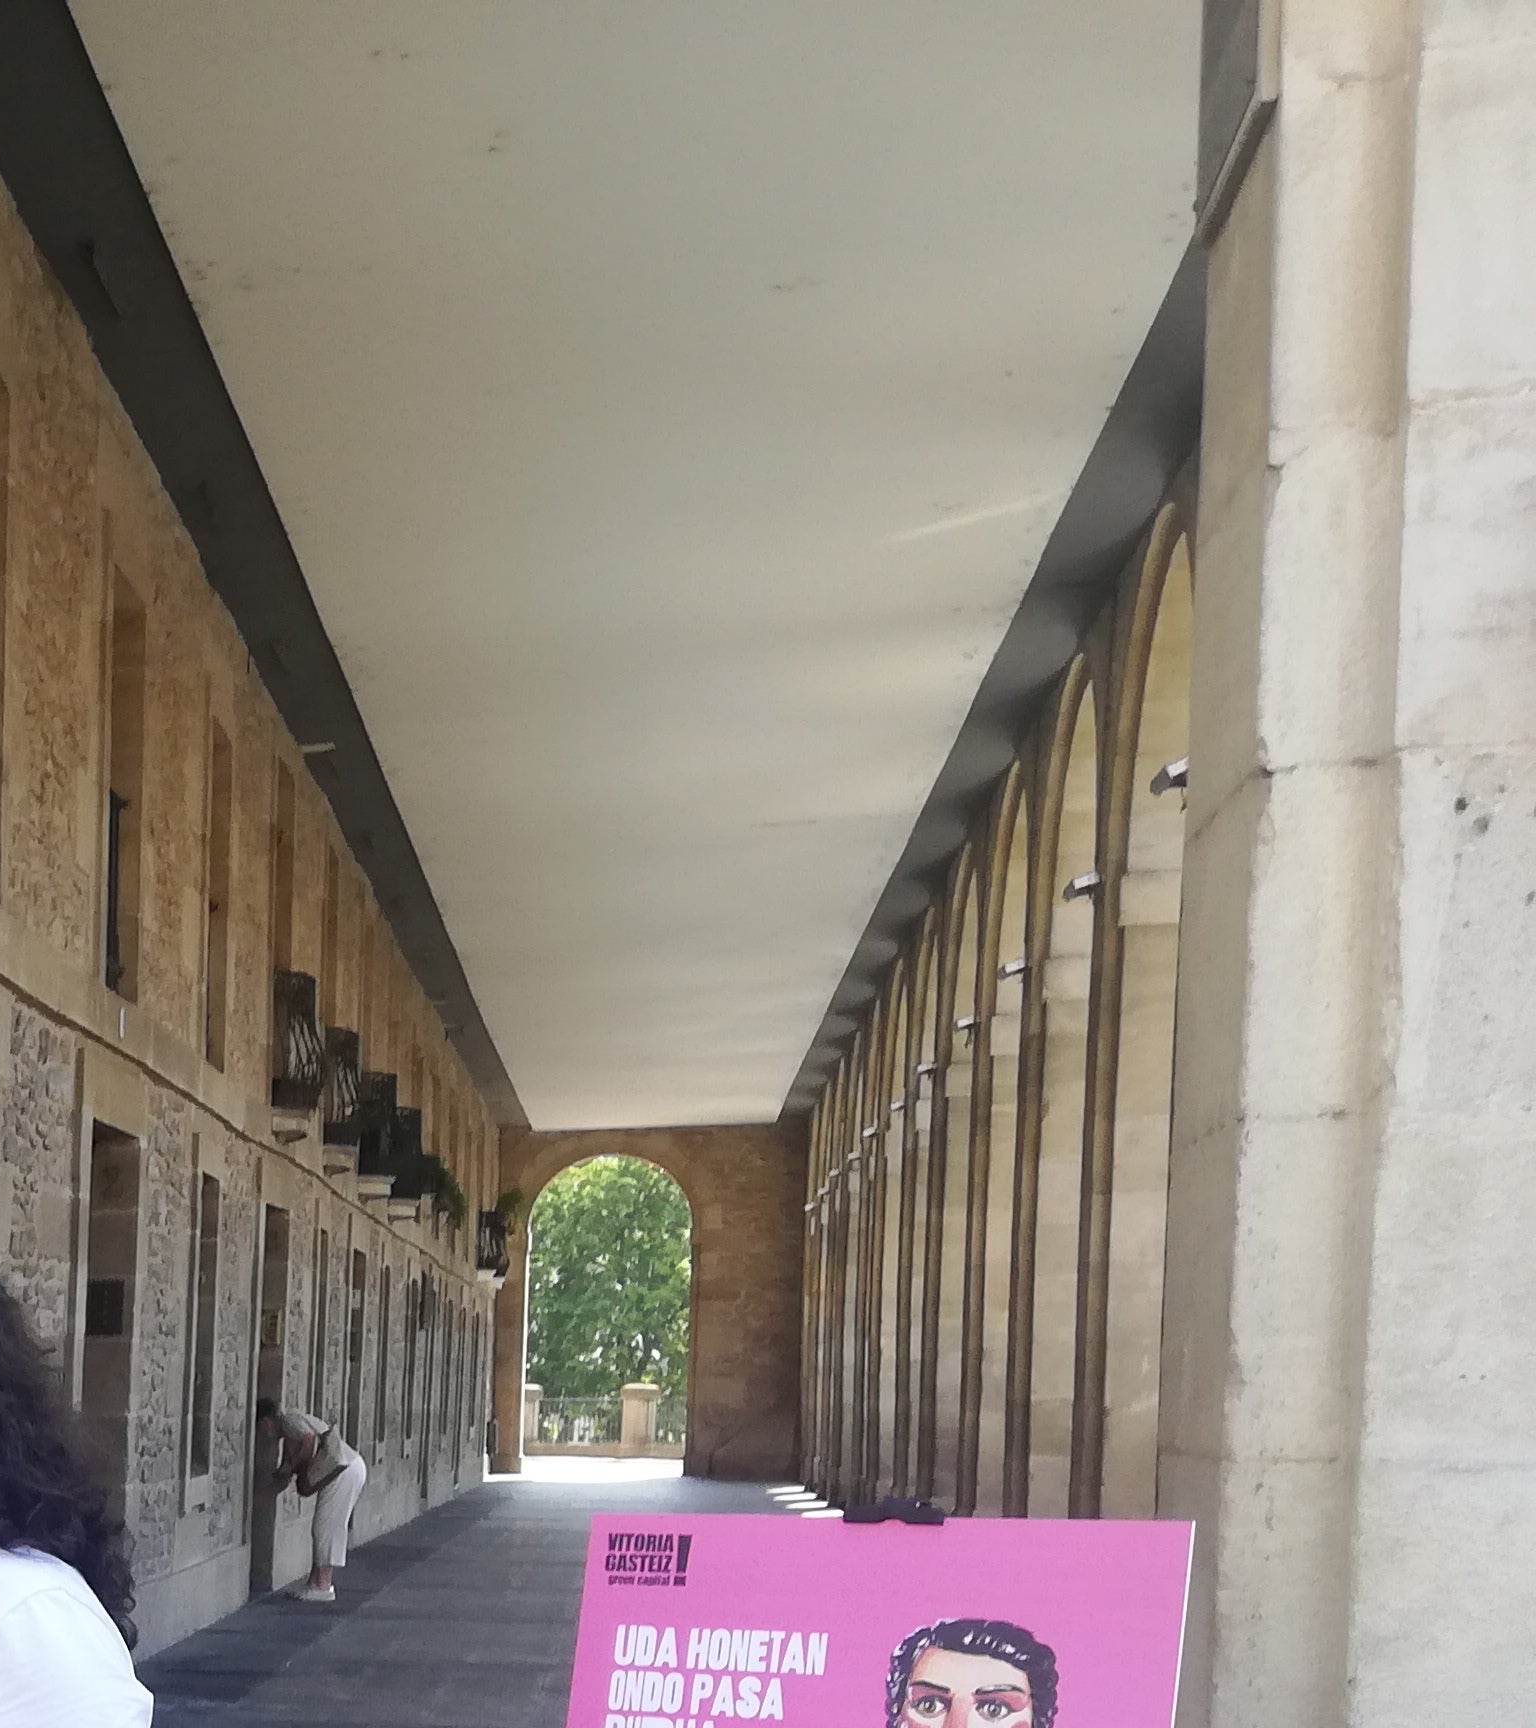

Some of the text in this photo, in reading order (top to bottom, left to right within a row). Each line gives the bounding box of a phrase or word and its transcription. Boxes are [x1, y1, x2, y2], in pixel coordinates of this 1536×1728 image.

[608, 1532, 674, 1553] VITORIA
[605, 1553, 672, 1573] GASTEIZ
[614, 1624, 828, 1676] UDA HONETAN
[608, 1669, 784, 1721] ONDO PASA
